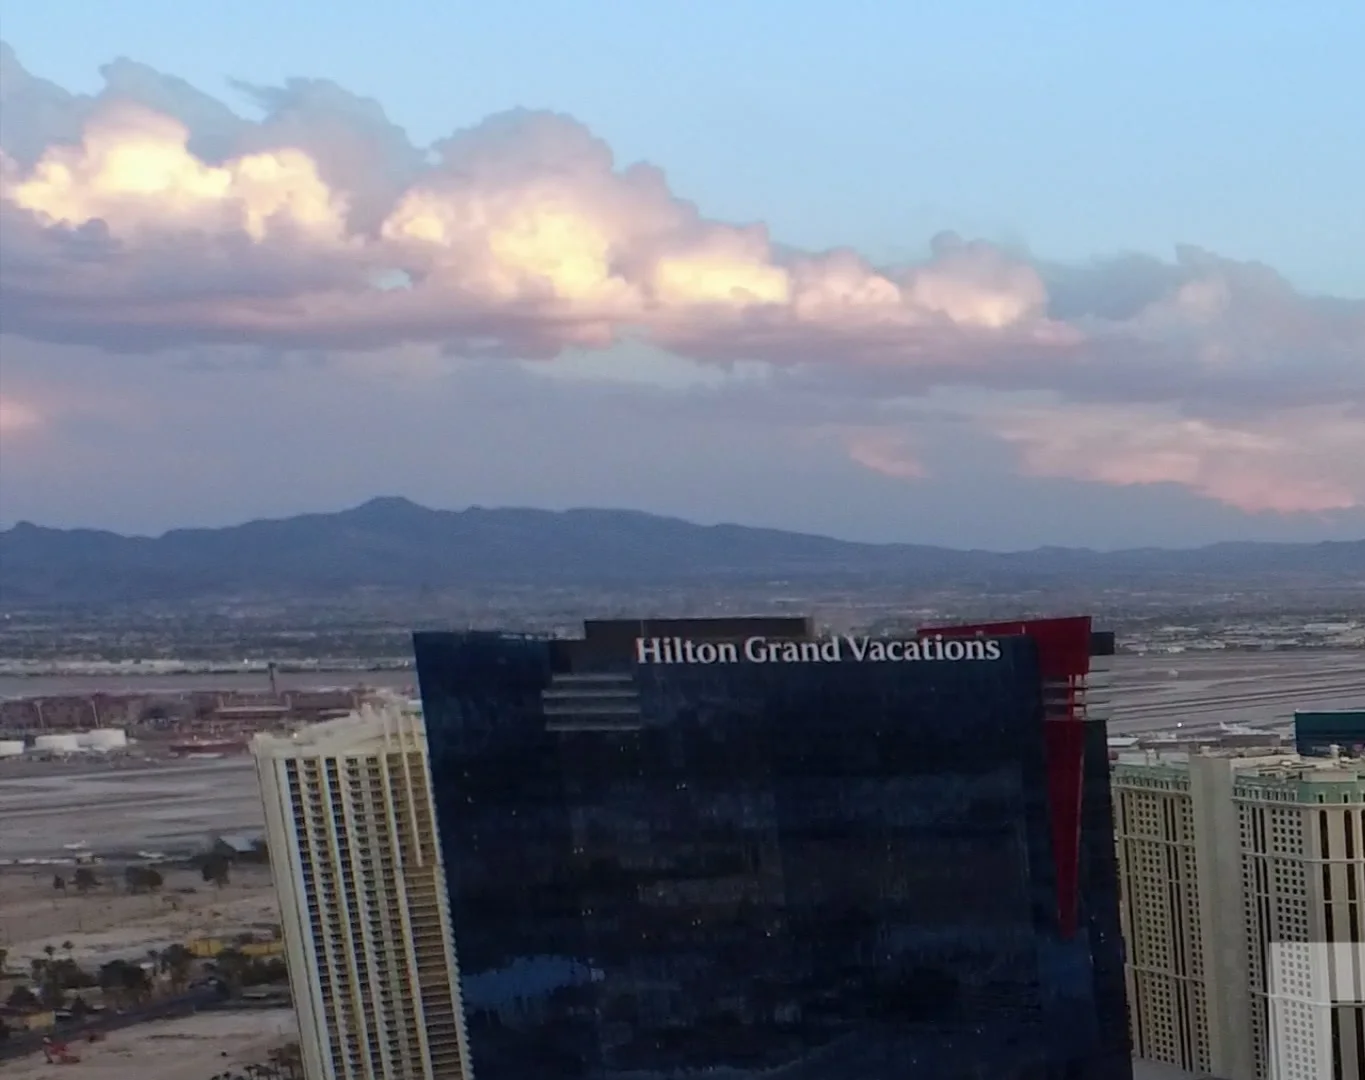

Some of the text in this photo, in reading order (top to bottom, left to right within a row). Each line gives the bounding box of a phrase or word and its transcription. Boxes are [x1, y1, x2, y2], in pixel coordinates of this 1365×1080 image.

[636, 634, 1001, 664] Hilton Grand Vacations
